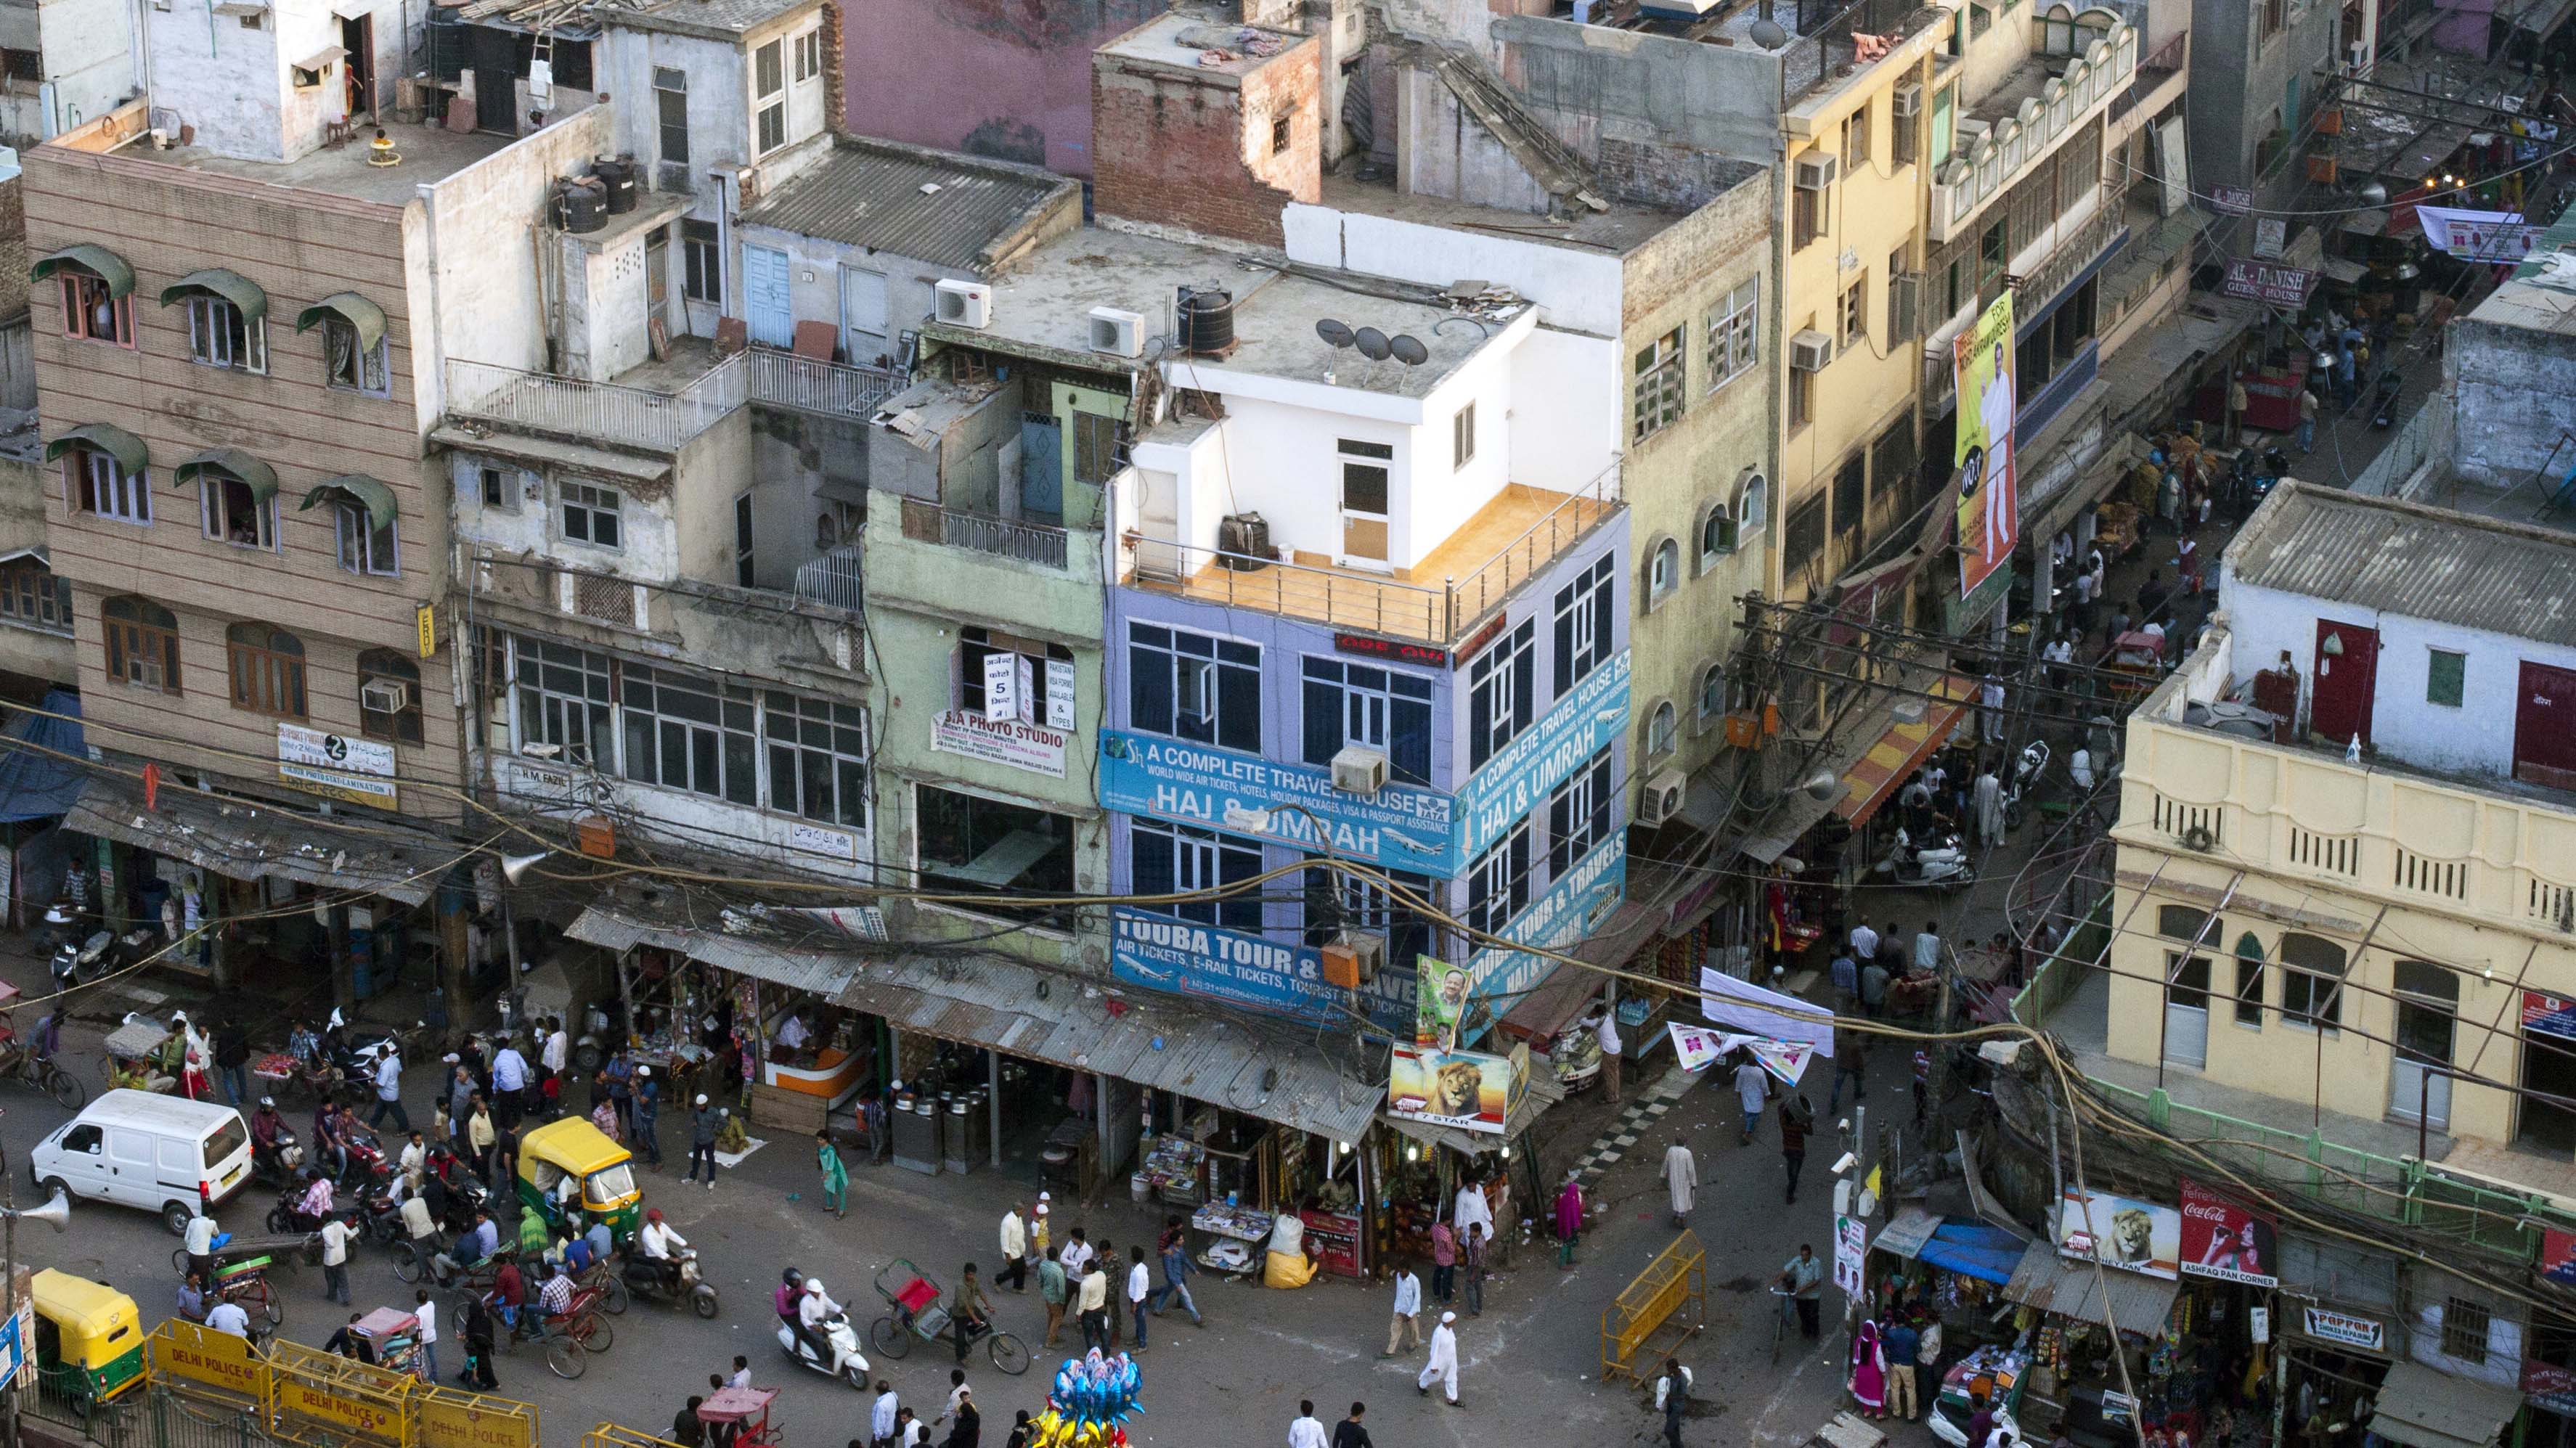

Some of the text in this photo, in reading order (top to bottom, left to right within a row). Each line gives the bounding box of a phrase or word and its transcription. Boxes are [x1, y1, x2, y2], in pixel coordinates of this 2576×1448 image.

[2230, 263, 2246, 282] AL
[2265, 288, 2302, 301] HOUSE
[995, 682, 1006, 693] 5
[1049, 676, 1058, 685] VISA
[1024, 698, 1030, 711] 5
[1057, 704, 1064, 713] &
[969, 714, 1012, 736] PHOTO
[1016, 726, 1063, 748] STUDIO
[971, 729, 988, 737] PHOTO
[1051, 716, 1070, 728] TYPES
[1478, 776, 1485, 796] A
[1487, 729, 1538, 787] COMPLETE
[1540, 698, 1577, 740] TRAVEL
[1578, 666, 1612, 708] HOUSE
[331, 735, 343, 758] 2
[973, 742, 1002, 753] PHOTOSTAT
[306, 771, 325, 780] PHOTO
[342, 777, 385, 793] LAMINATION
[543, 774, 566, 787] FAZIL
[1147, 744, 1160, 762] A
[1165, 747, 1265, 784] COMPLETE
[1271, 769, 1342, 799] TRAVEL
[1348, 790, 1414, 813] HOUSE
[1481, 719, 1595, 845] HAJ & UMRAH
[1147, 764, 1450, 835] WORLD WIDE AIR TICKETS, HOTELS, HOLIDAY PACKAGES, VISA & PASSPORT ASSISTANCE
[1157, 785, 1211, 819] HAJ
[1257, 806, 1379, 854] UMRAH
[1516, 896, 1552, 944] TOUR
[1556, 889, 1566, 912] &
[1568, 832, 1624, 899] TRAVELS
[1115, 912, 1316, 980] TOOBA TOUR &
[1116, 938, 1135, 954] AIR
[1138, 944, 1189, 968] TICKETS,
[1193, 956, 1231, 976] E-RAIL
[1235, 965, 1286, 991] TICKETS,
[1507, 962, 1528, 993] HAJ
[1530, 956, 1539, 977] &
[1433, 1116, 1470, 1126] STAR
[2123, 1263, 2140, 1272] PAN
[2185, 1264, 2275, 1286] ASHFAQ PAN CORNER
[172, 1349, 242, 1377] DELHI POLICE
[303, 1391, 372, 1421] DELHI POLICE
[431, 1421, 515, 1447] DELHI POLICE
